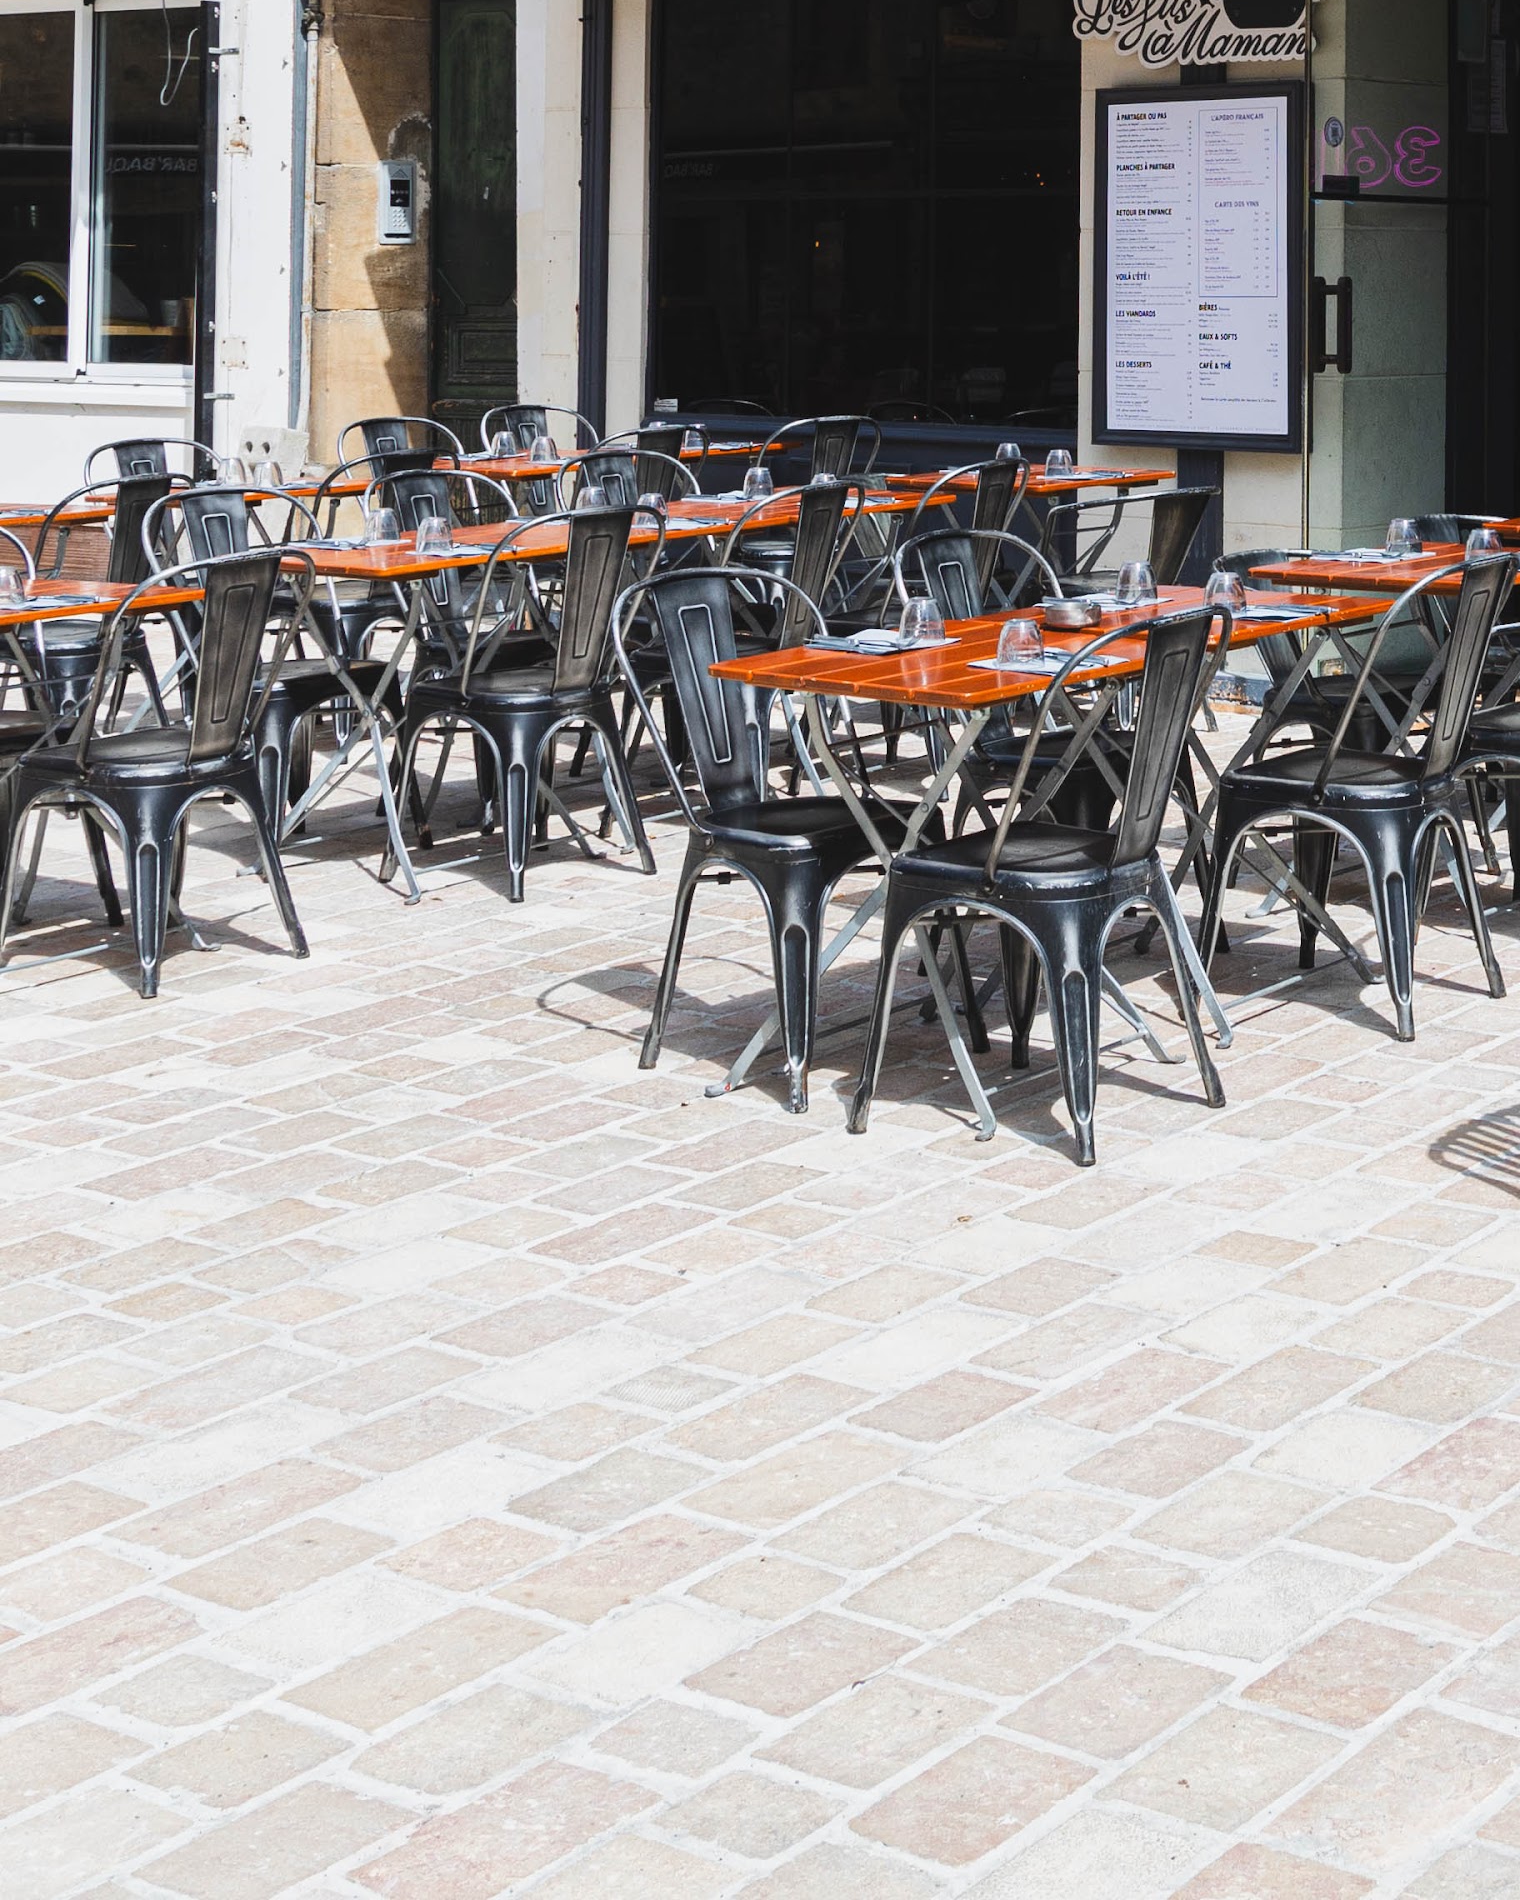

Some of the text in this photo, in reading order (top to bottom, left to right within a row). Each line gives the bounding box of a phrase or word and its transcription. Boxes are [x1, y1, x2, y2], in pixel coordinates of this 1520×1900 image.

[1143, 3, 1305, 63] à Maman
[1148, 112, 1156, 120] OU
[1149, 162, 1175, 170] PARTAGER
[1116, 208, 1137, 216] RETOUR
[1115, 271, 1131, 280] VOILÀ
[1198, 301, 1217, 311] BIÈRES
[1199, 360, 1213, 369] CAFÉ
[1220, 360, 1231, 369] THÉ
